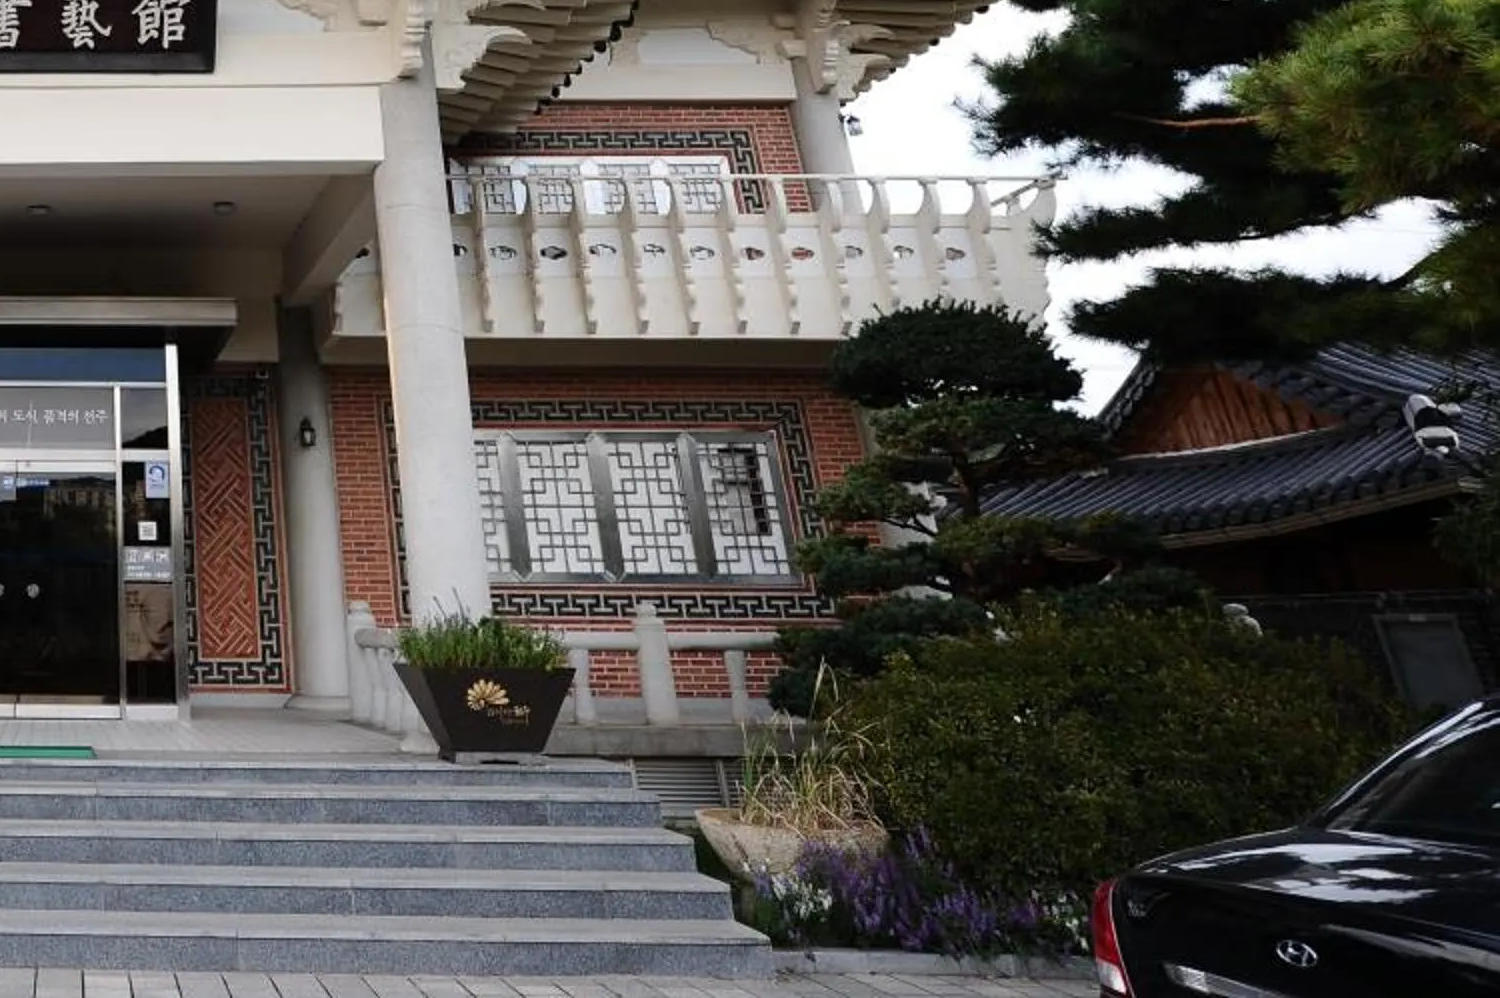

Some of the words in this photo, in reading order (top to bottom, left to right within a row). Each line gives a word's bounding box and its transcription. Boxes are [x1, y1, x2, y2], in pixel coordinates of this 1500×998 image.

[10, 409, 38, 424] 도시
[43, 409, 79, 425] 품격의
[83, 409, 109, 424] 전주
